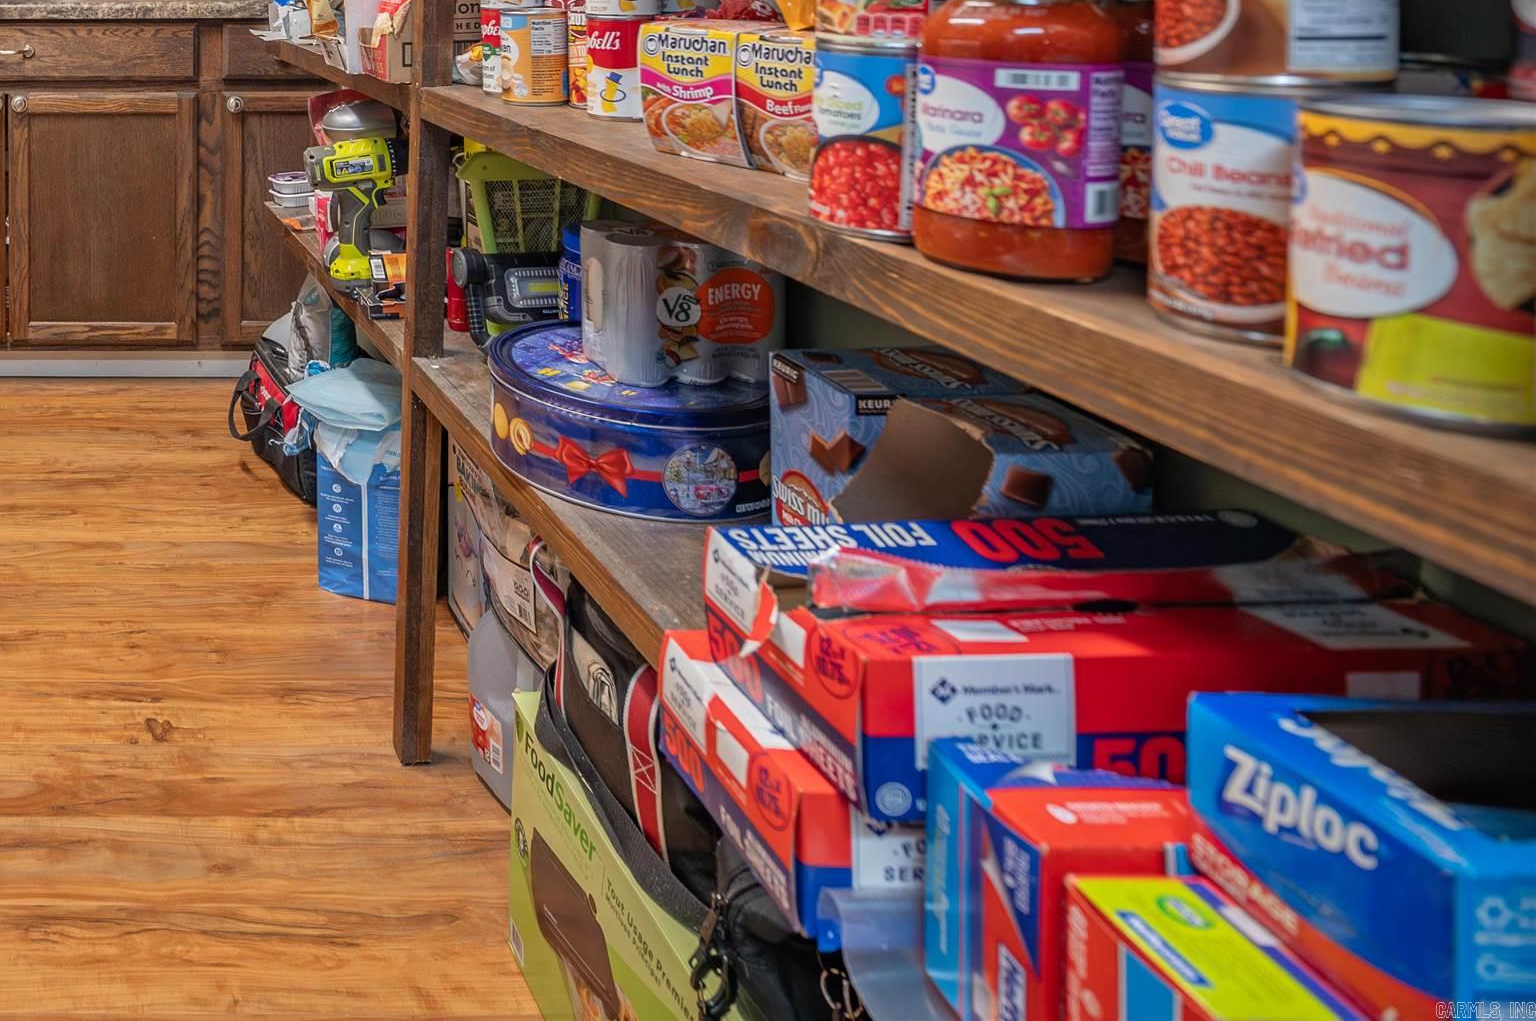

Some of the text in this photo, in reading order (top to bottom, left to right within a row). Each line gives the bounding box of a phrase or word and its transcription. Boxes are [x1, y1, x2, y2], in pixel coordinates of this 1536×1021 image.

[658, 33, 727, 55] Maruchan
[661, 51, 710, 67] Instant
[667, 64, 704, 79] Lunch
[755, 62, 804, 80] Instant
[671, 83, 714, 100] Shrimp
[759, 75, 799, 93] Lunch
[766, 97, 793, 116] Beef
[1166, 156, 1205, 178] Chili
[707, 283, 762, 306] ENERGY
[772, 359, 800, 380] KEURIG
[772, 475, 805, 518] SWISS
[728, 520, 938, 553] SHEETS FOIL
[952, 519, 1105, 563] 500
[966, 702, 1023, 724] FOOD
[664, 721, 704, 793] 500
[524, 730, 597, 862] FoodSaver
[1221, 742, 1379, 871] Ziploc
[606, 878, 625, 916] Tout
[626, 913, 654, 962] Usage
